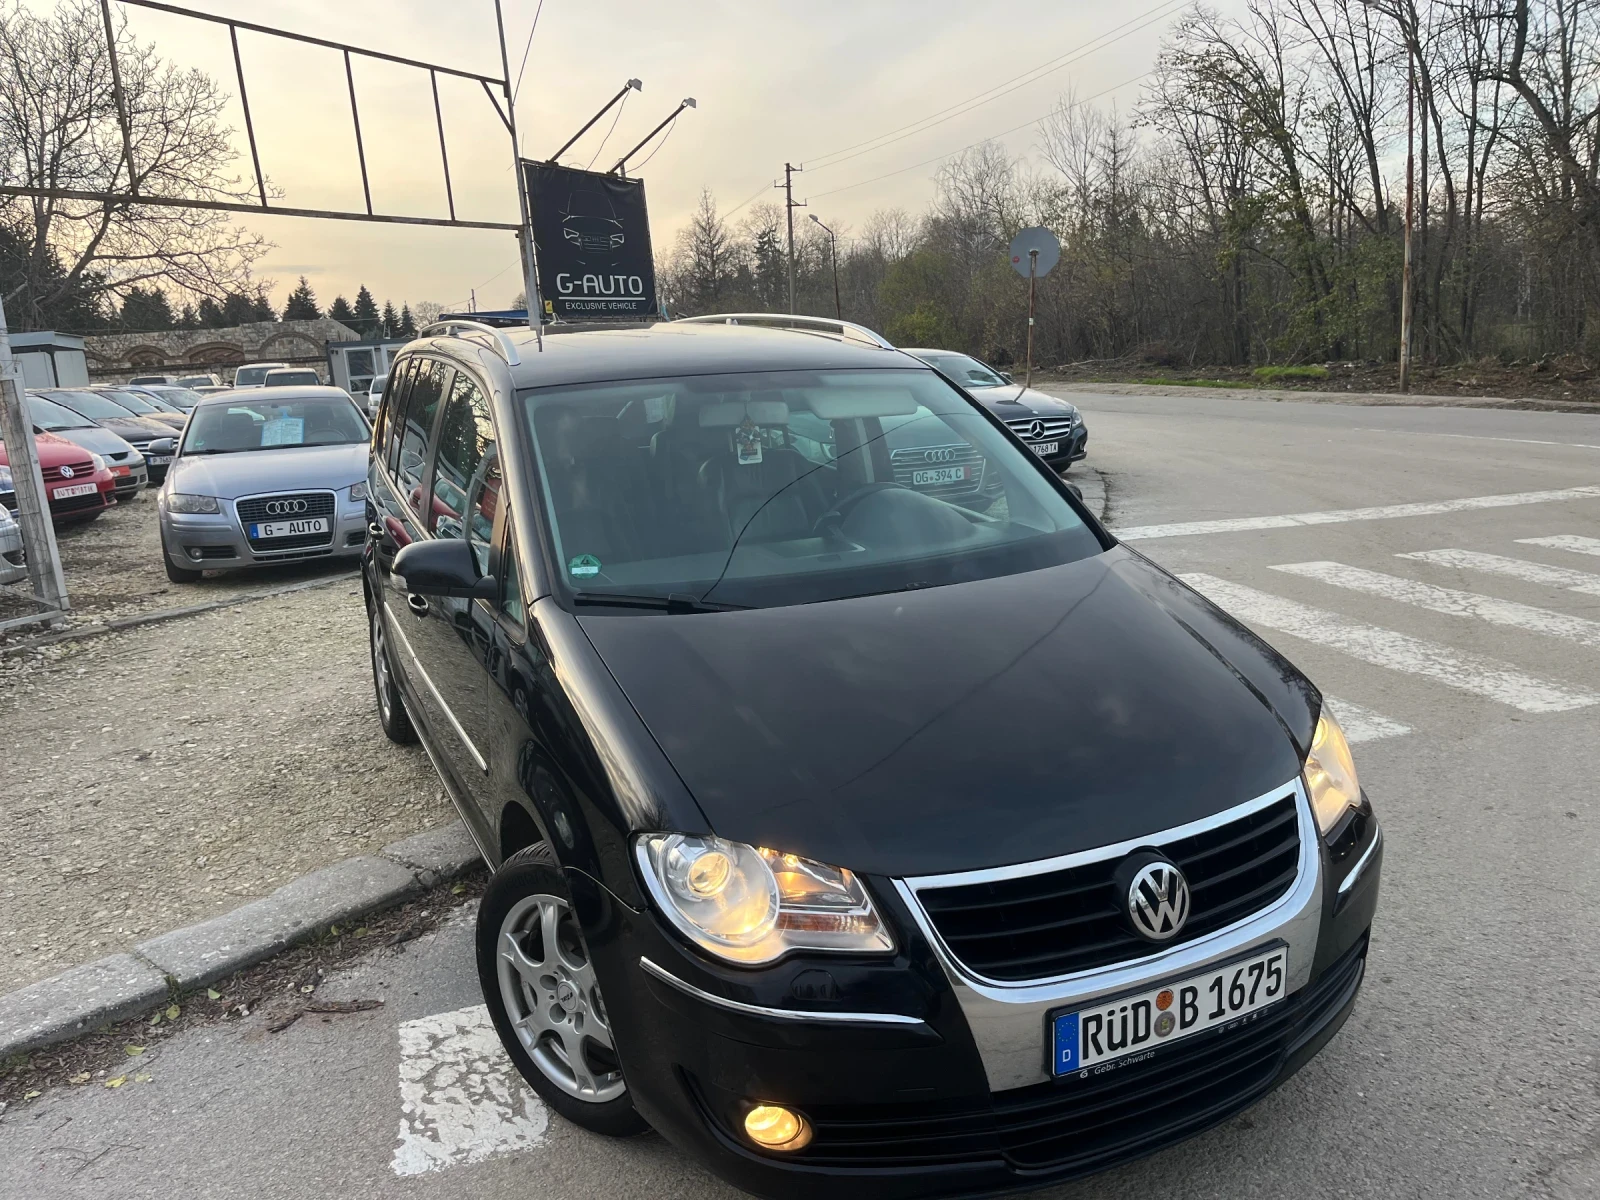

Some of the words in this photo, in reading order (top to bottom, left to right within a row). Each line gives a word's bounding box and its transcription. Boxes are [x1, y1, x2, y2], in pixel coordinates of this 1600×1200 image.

[556, 273, 643, 295] G-AUTO
[565, 302, 607, 310] EXCLUSIVE
[608, 302, 637, 310] VEHICLE
[934, 469, 952, 481] 394
[955, 468, 962, 479] C
[289, 520, 321, 534] AUTO
[1062, 1049, 1071, 1062] D
[1179, 985, 1199, 1030] B
[1208, 954, 1282, 1021] 1675
[1094, 1063, 1116, 1075] Gebr.
[1118, 1051, 1156, 1068] Schwarte
